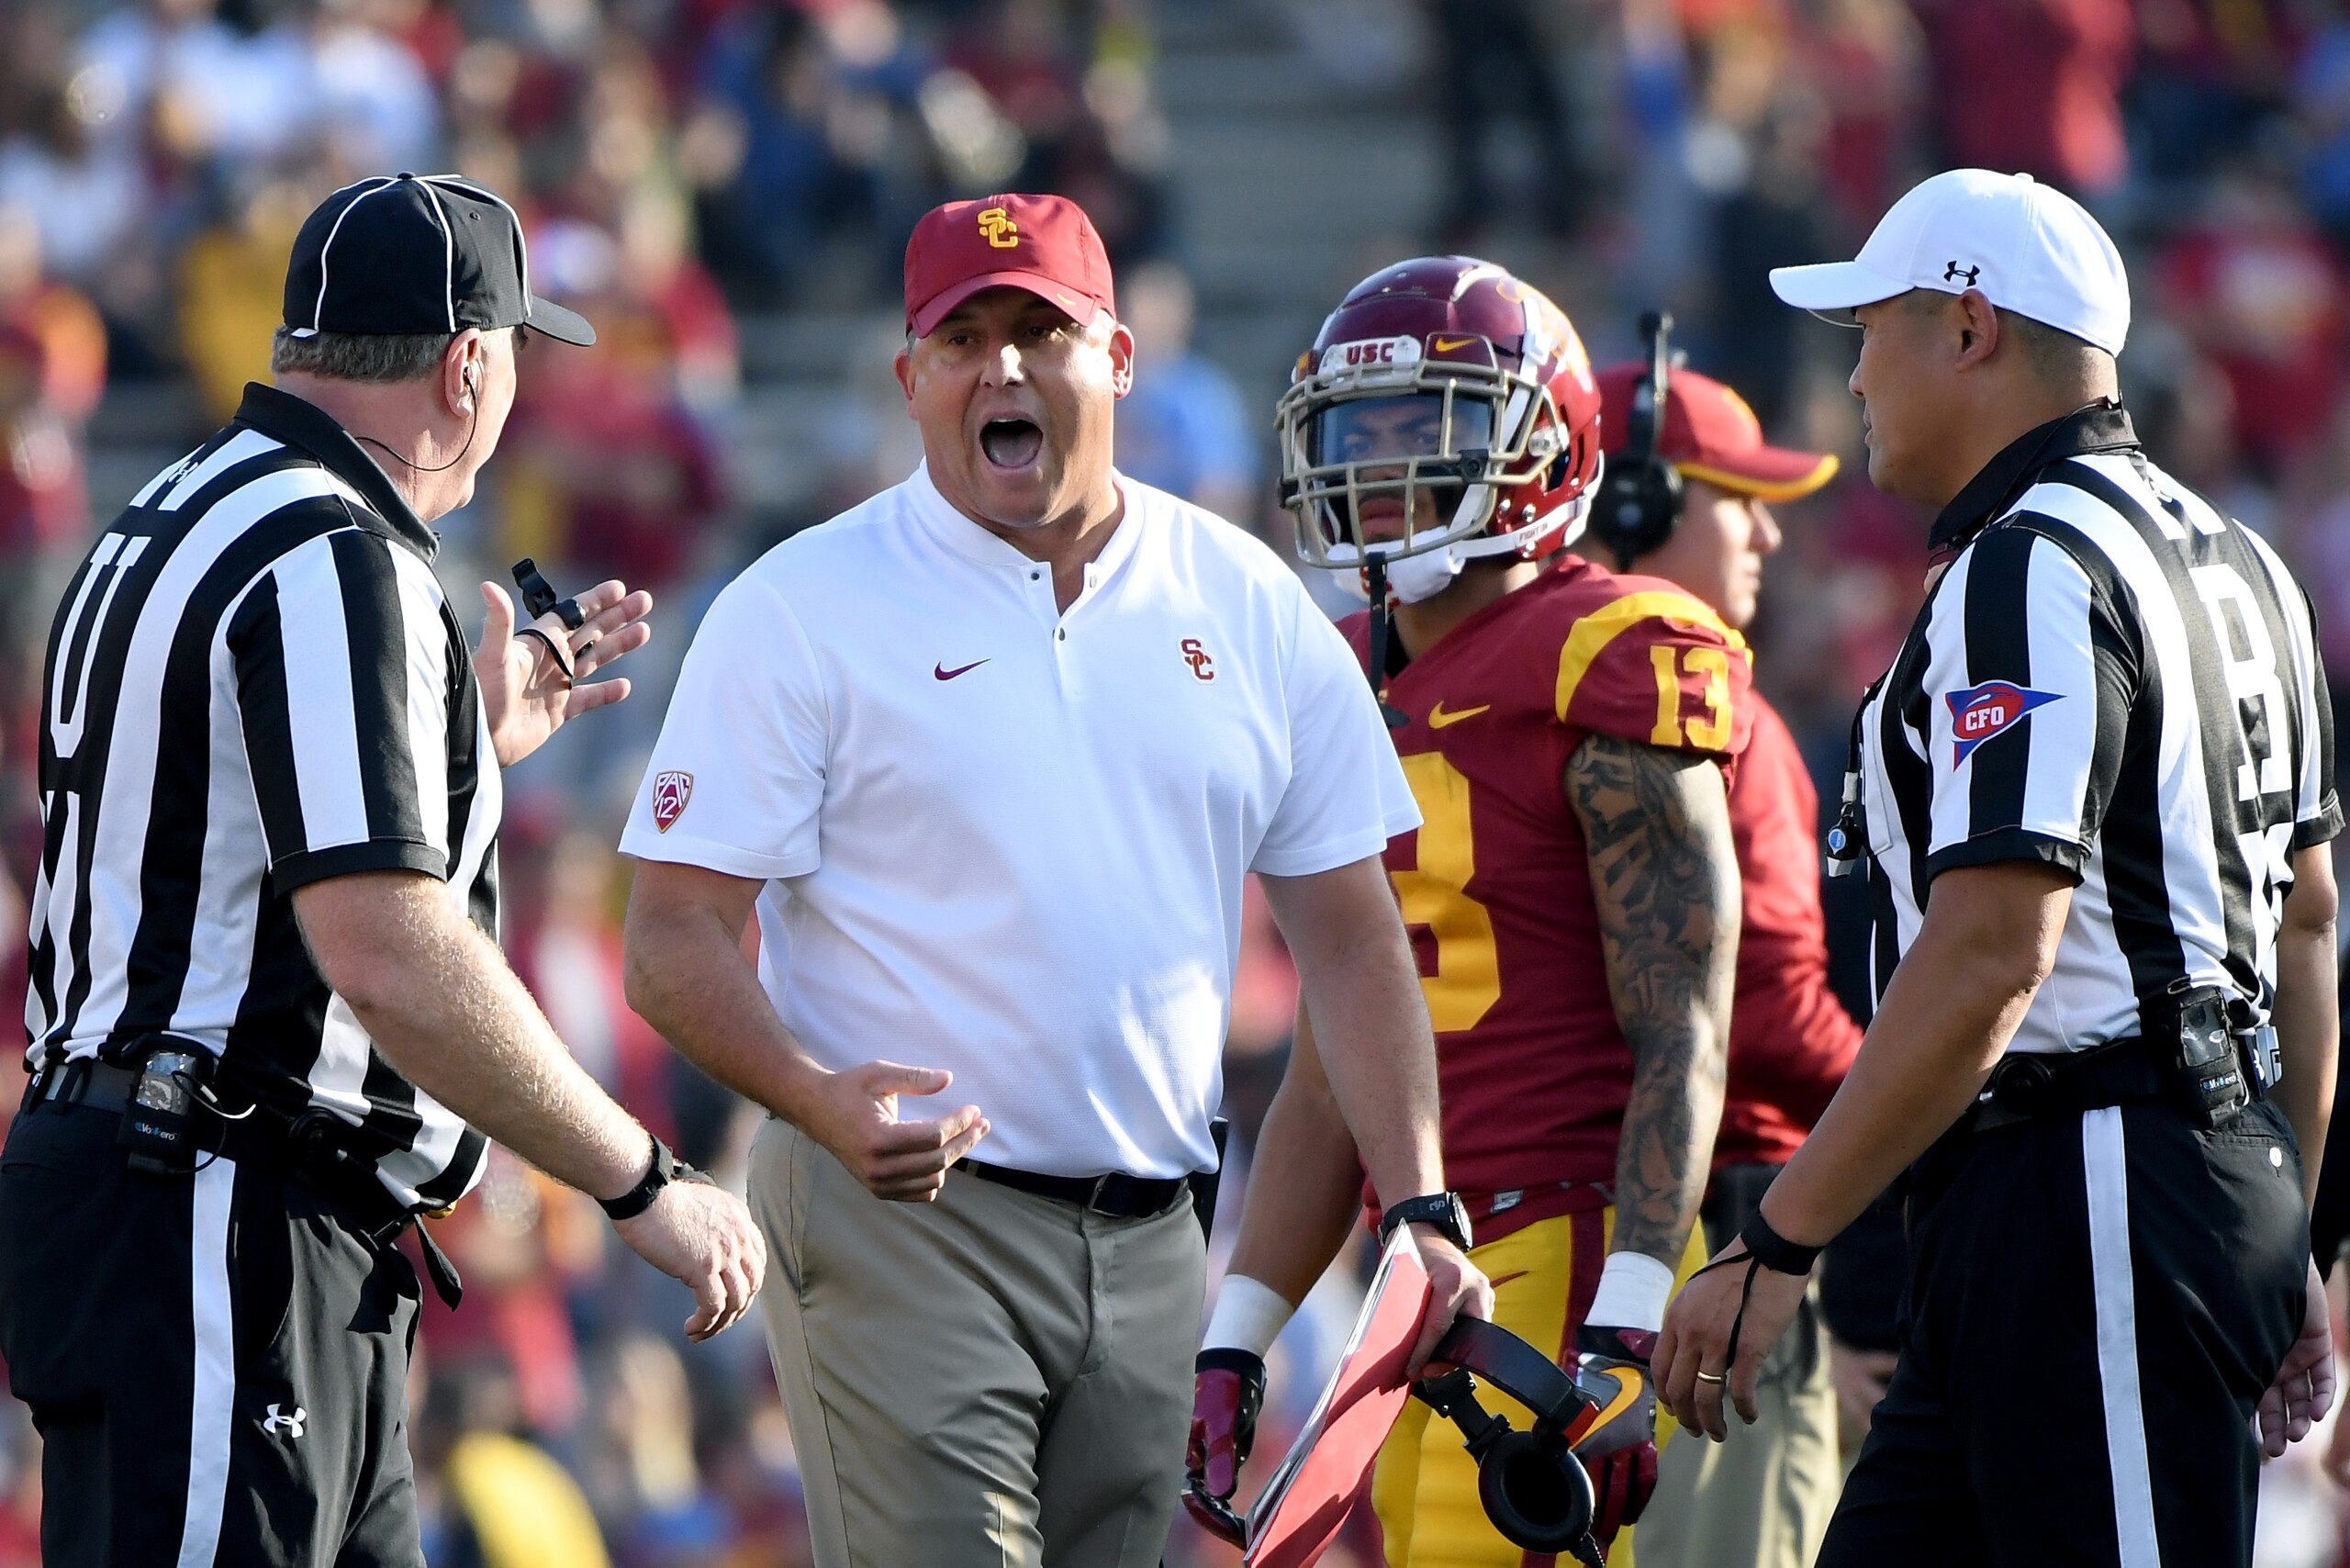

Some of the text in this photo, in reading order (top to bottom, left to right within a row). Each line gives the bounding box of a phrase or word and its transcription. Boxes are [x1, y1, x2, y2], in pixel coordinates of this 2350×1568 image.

[978, 207, 1018, 248] SC
[1346, 342, 1394, 365] USC
[50, 532, 151, 759] U
[1181, 639, 1214, 680] SC
[1650, 644, 1733, 751] 13
[1965, 706, 2005, 732] CFO
[655, 772, 690, 808] PAC
[656, 796, 678, 819] 12
